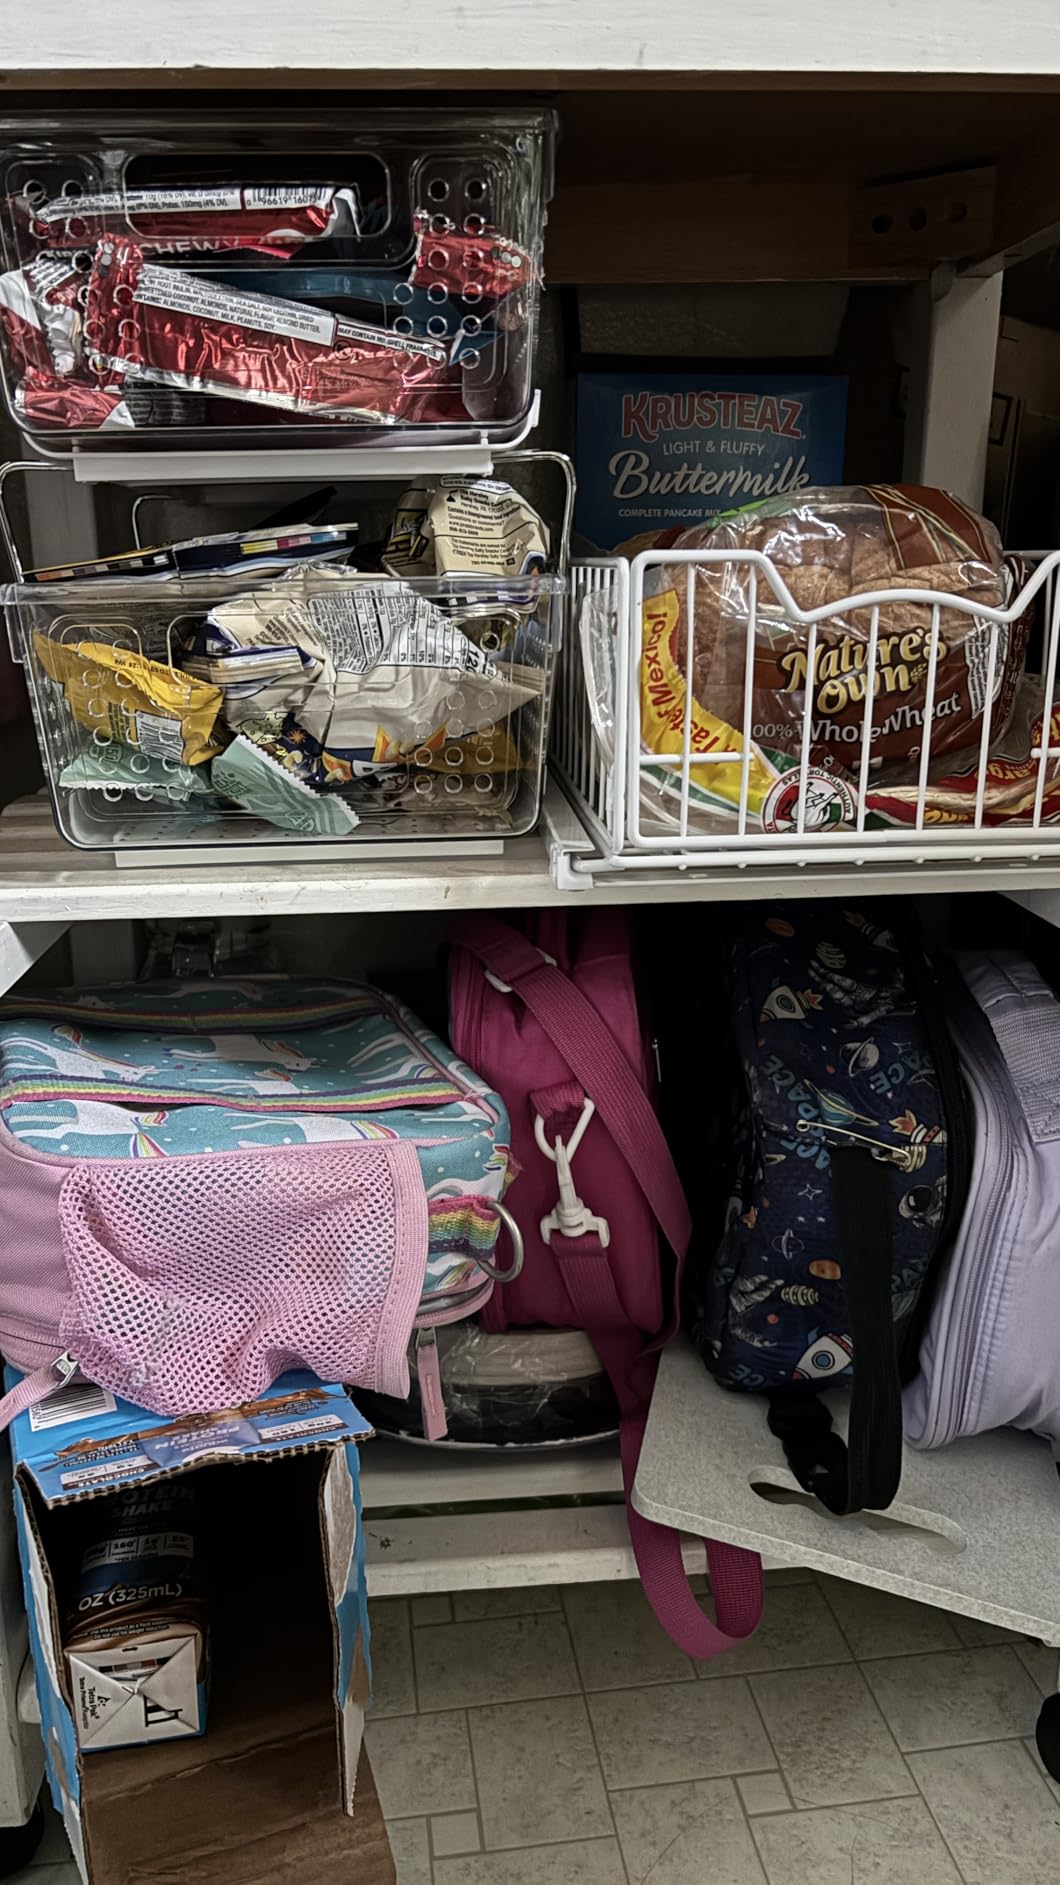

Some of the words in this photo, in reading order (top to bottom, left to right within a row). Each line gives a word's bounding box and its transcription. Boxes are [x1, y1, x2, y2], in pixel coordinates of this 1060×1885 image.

[139, 236, 240, 255] CHEWY
[621, 391, 803, 443] KRUSTEAZ
[663, 440, 700, 455] LIGHT
[705, 440, 716, 453] &
[720, 441, 766, 456] FLUFFY
[608, 450, 810, 499] Buttermilk
[618, 509, 662, 518] COMPLETE
[664, 509, 703, 518] PANCAKE
[645, 612, 676, 707] Mexico!
[781, 628, 947, 693] Nature's
[817, 664, 912, 714] Own
[753, 722, 794, 739] 00%
[883, 692, 962, 734] Wheat
[826, 772, 852, 814] AUTHENTIC
[152, 1424, 241, 1449] PROTEIN
[76, 1467, 145, 1487] CHOCOLATE
[79, 1593, 104, 1611] OZ
[108, 1583, 183, 1605] (325mL)
[88, 1686, 96, 1703] Tetra
